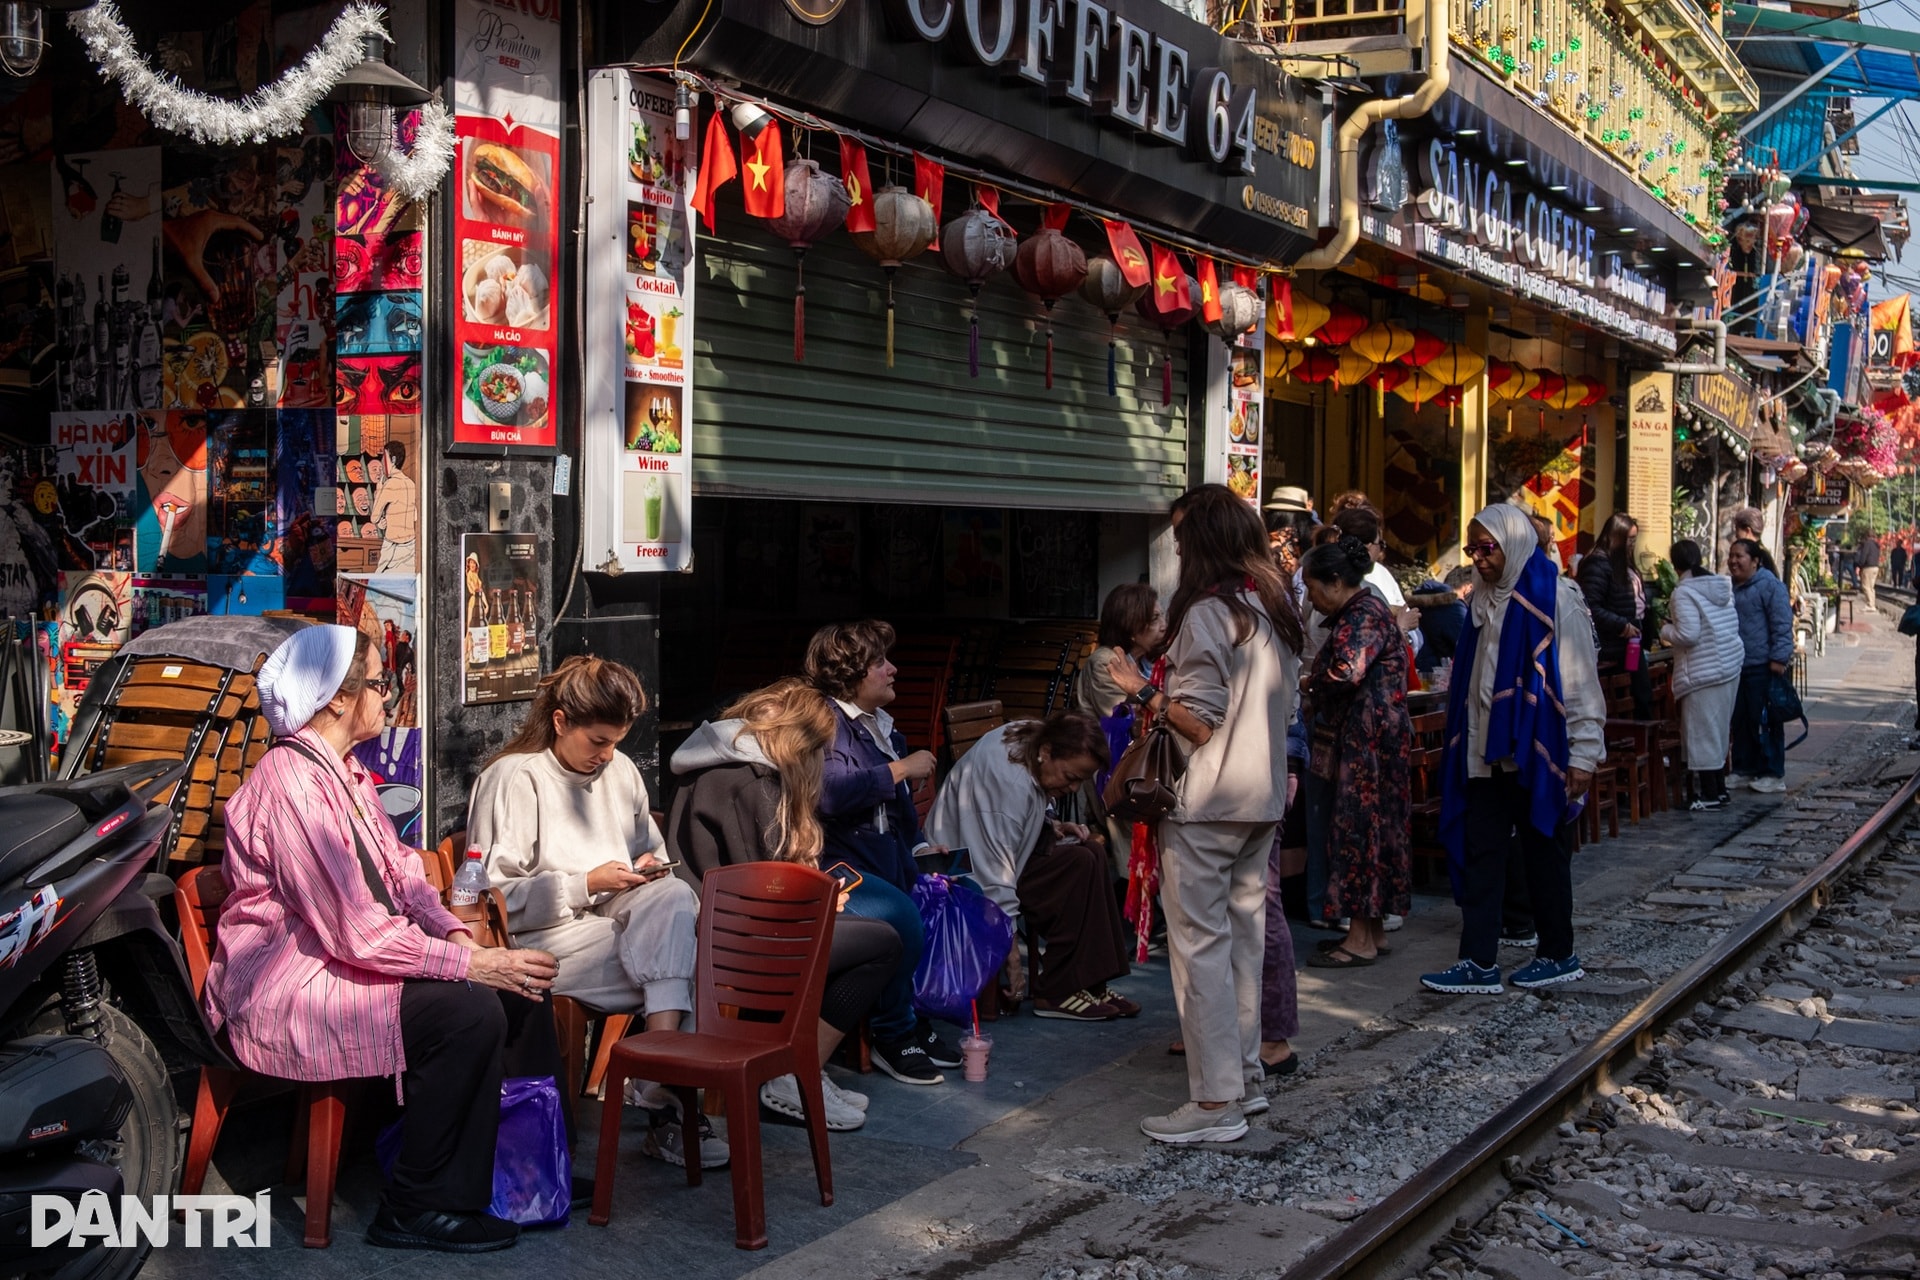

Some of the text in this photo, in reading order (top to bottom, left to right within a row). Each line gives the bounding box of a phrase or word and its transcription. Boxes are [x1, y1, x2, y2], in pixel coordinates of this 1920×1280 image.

[475, 9, 541, 59] Premium
[499, 55, 520, 68] BEER
[1207, 69, 1257, 177] 64
[642, 187, 673, 205] Mojito
[491, 228, 512, 241] BÁNH
[1424, 223, 1473, 270] Vietnamese
[636, 276, 676, 295] Cocktail
[494, 329, 504, 339] HÁ
[624, 366, 643, 379] Juice
[649, 369, 684, 383] Smoothies
[1654, 422, 1668, 431] GA
[491, 429, 505, 441] BÚN
[638, 456, 669, 471] Wine
[1806, 489, 1842, 497] FOD
[637, 545, 668, 558] Freeze
[453, 893, 477, 903] evian
